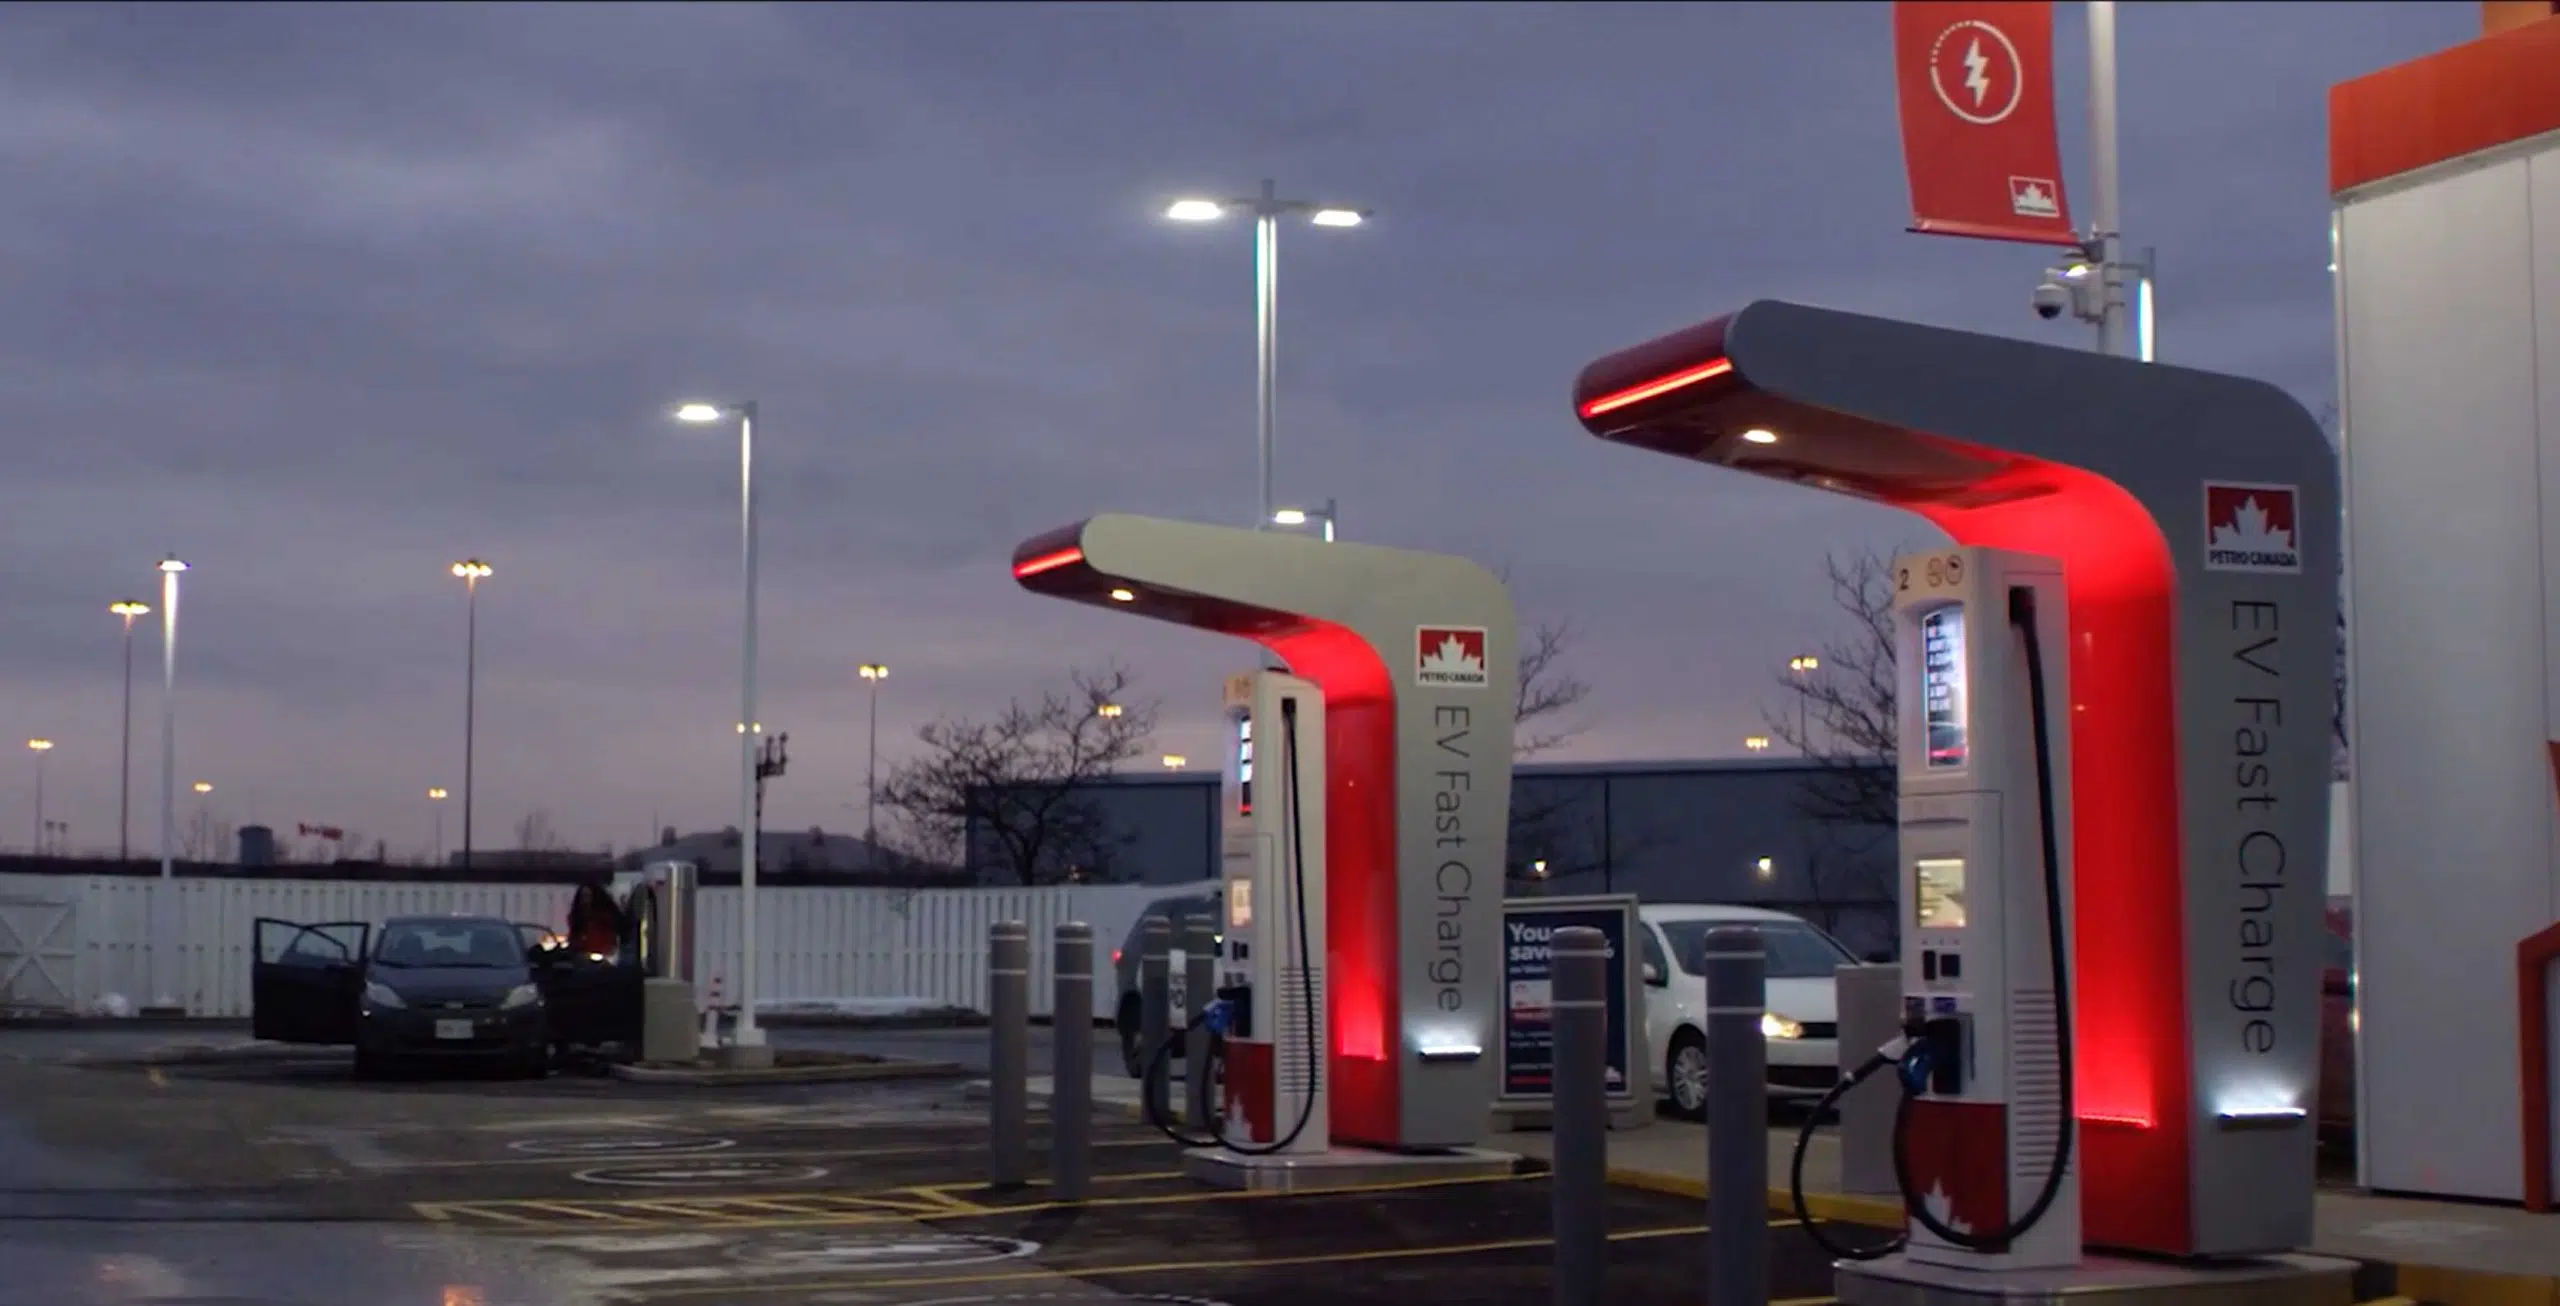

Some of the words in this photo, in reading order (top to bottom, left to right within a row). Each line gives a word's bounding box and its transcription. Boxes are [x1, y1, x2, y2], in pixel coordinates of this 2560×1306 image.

[1900, 568, 1909, 591] 2
[2231, 600, 2280, 676] EV
[1434, 705, 1471, 758] EV
[2233, 696, 2282, 811] Fast
[1435, 770, 1471, 848] Fast
[1428, 860, 1472, 1013] Charge
[1508, 922, 1550, 942] You
[1509, 945, 1553, 961] sav
[2229, 830, 2286, 1054] Charge
